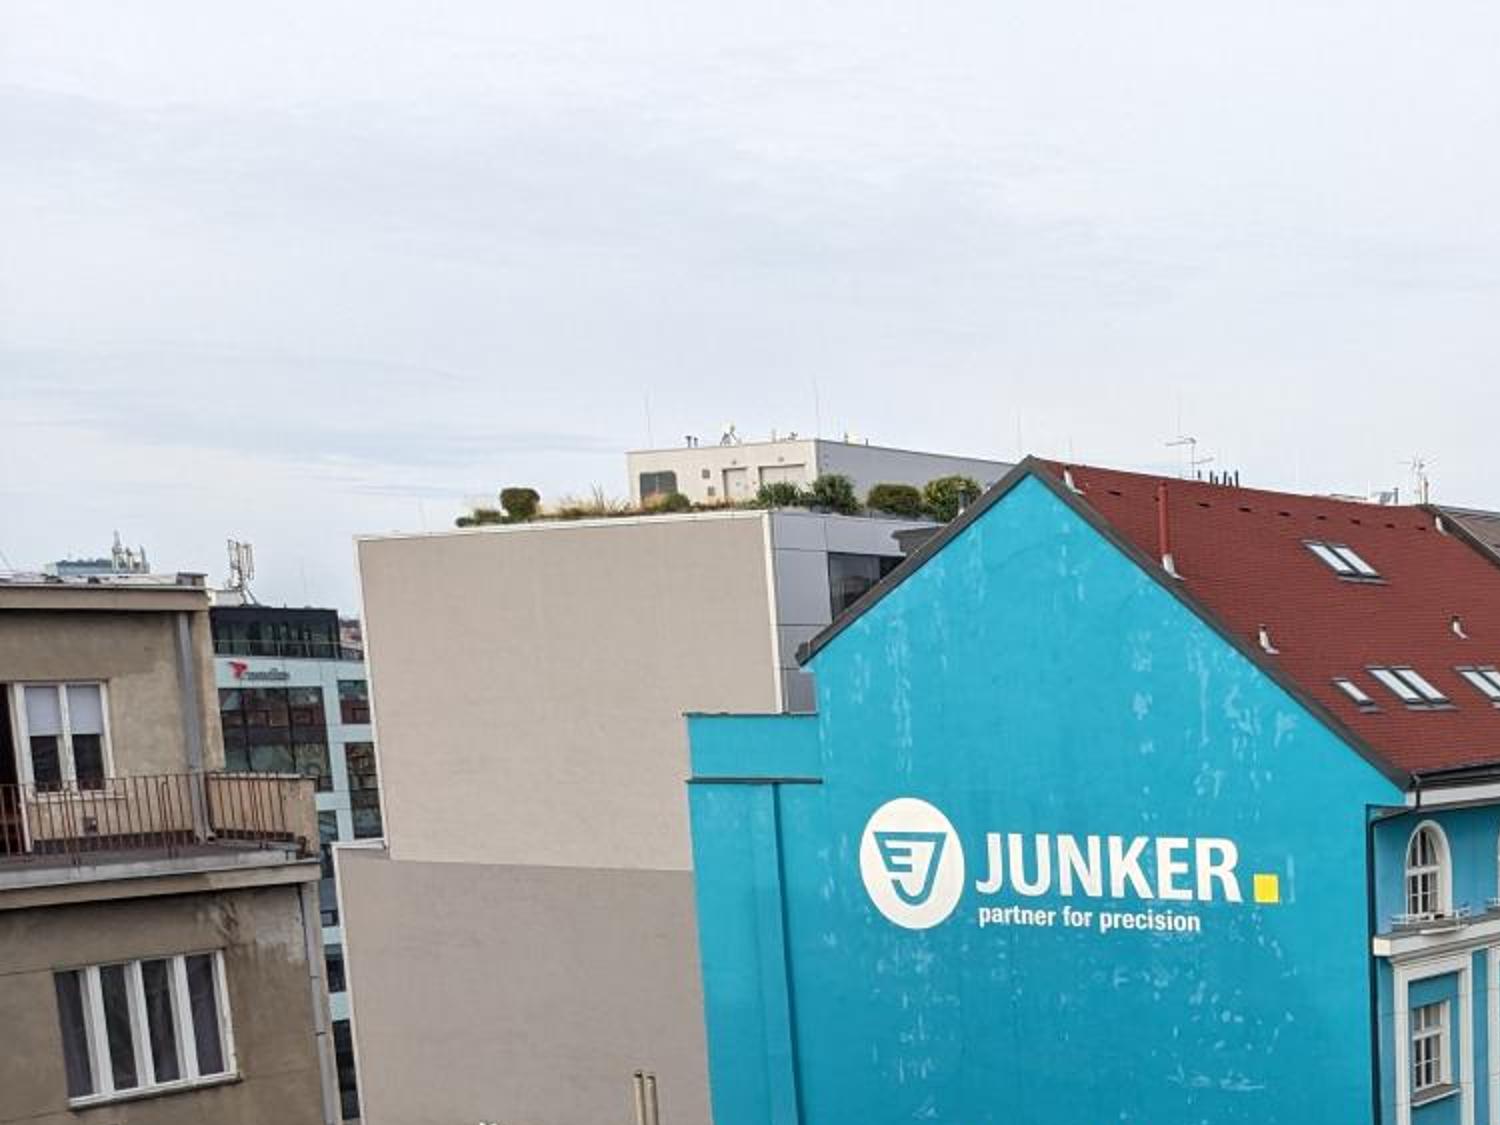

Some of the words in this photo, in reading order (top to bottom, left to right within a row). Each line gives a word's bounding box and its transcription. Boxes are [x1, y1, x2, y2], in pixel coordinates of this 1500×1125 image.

[978, 905, 1056, 928] partner
[1062, 905, 1092, 926] for
[1100, 907, 1200, 932] precision
